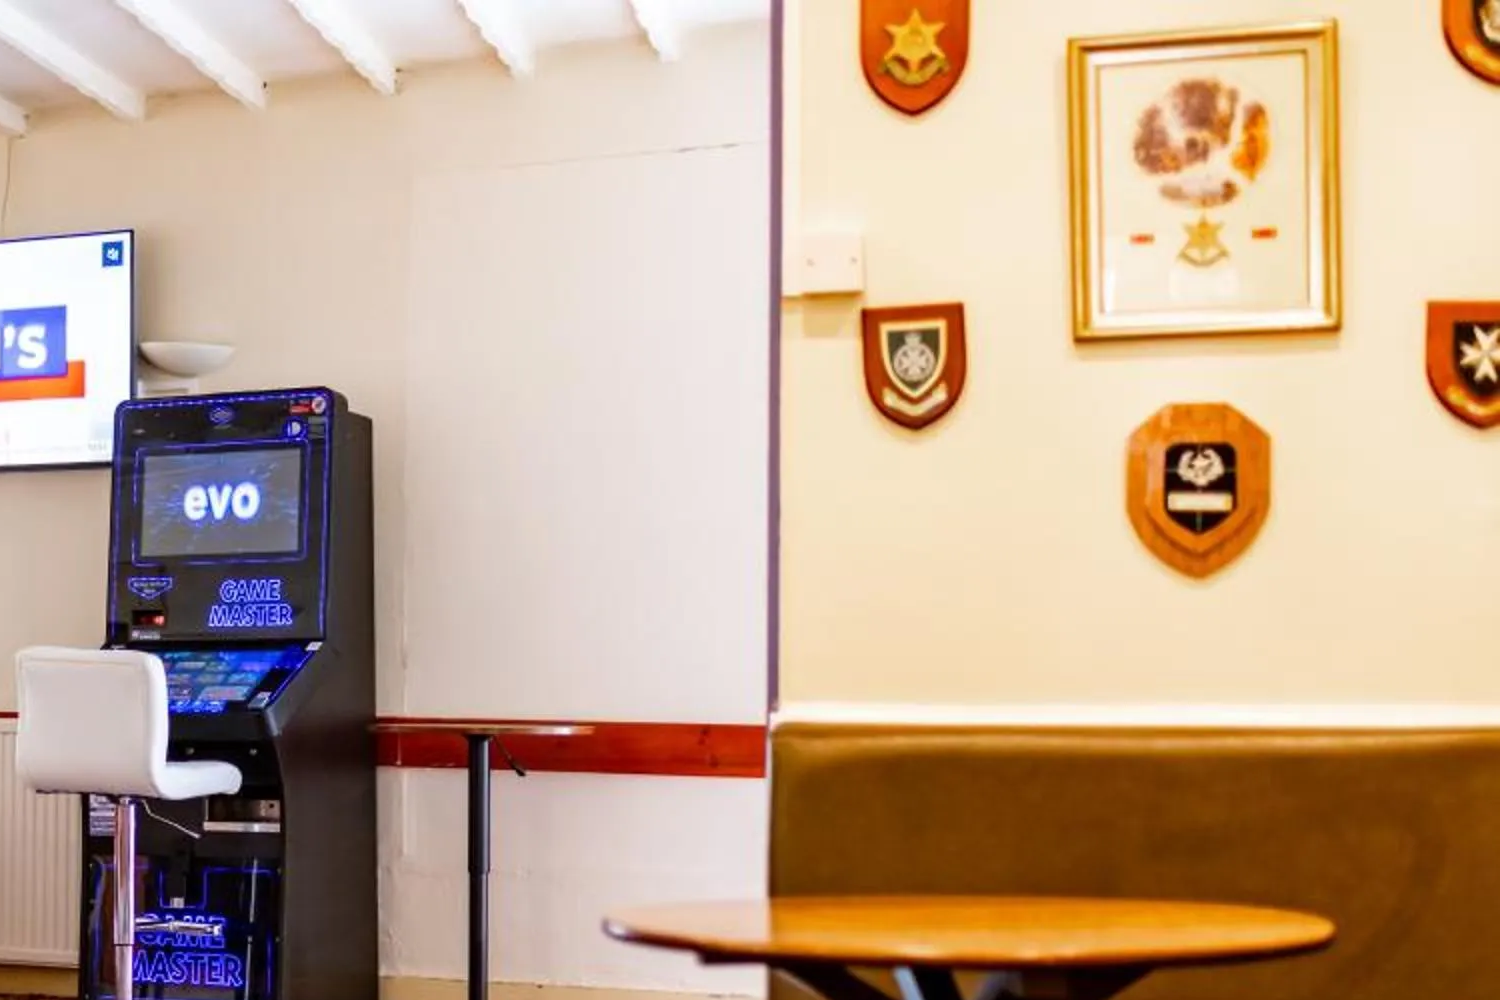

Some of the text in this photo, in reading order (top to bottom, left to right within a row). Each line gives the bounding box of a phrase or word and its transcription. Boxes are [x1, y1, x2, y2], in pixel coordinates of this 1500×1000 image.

[184, 481, 260, 520] evo
[220, 579, 281, 603] GAME
[208, 603, 293, 627] MASTER
